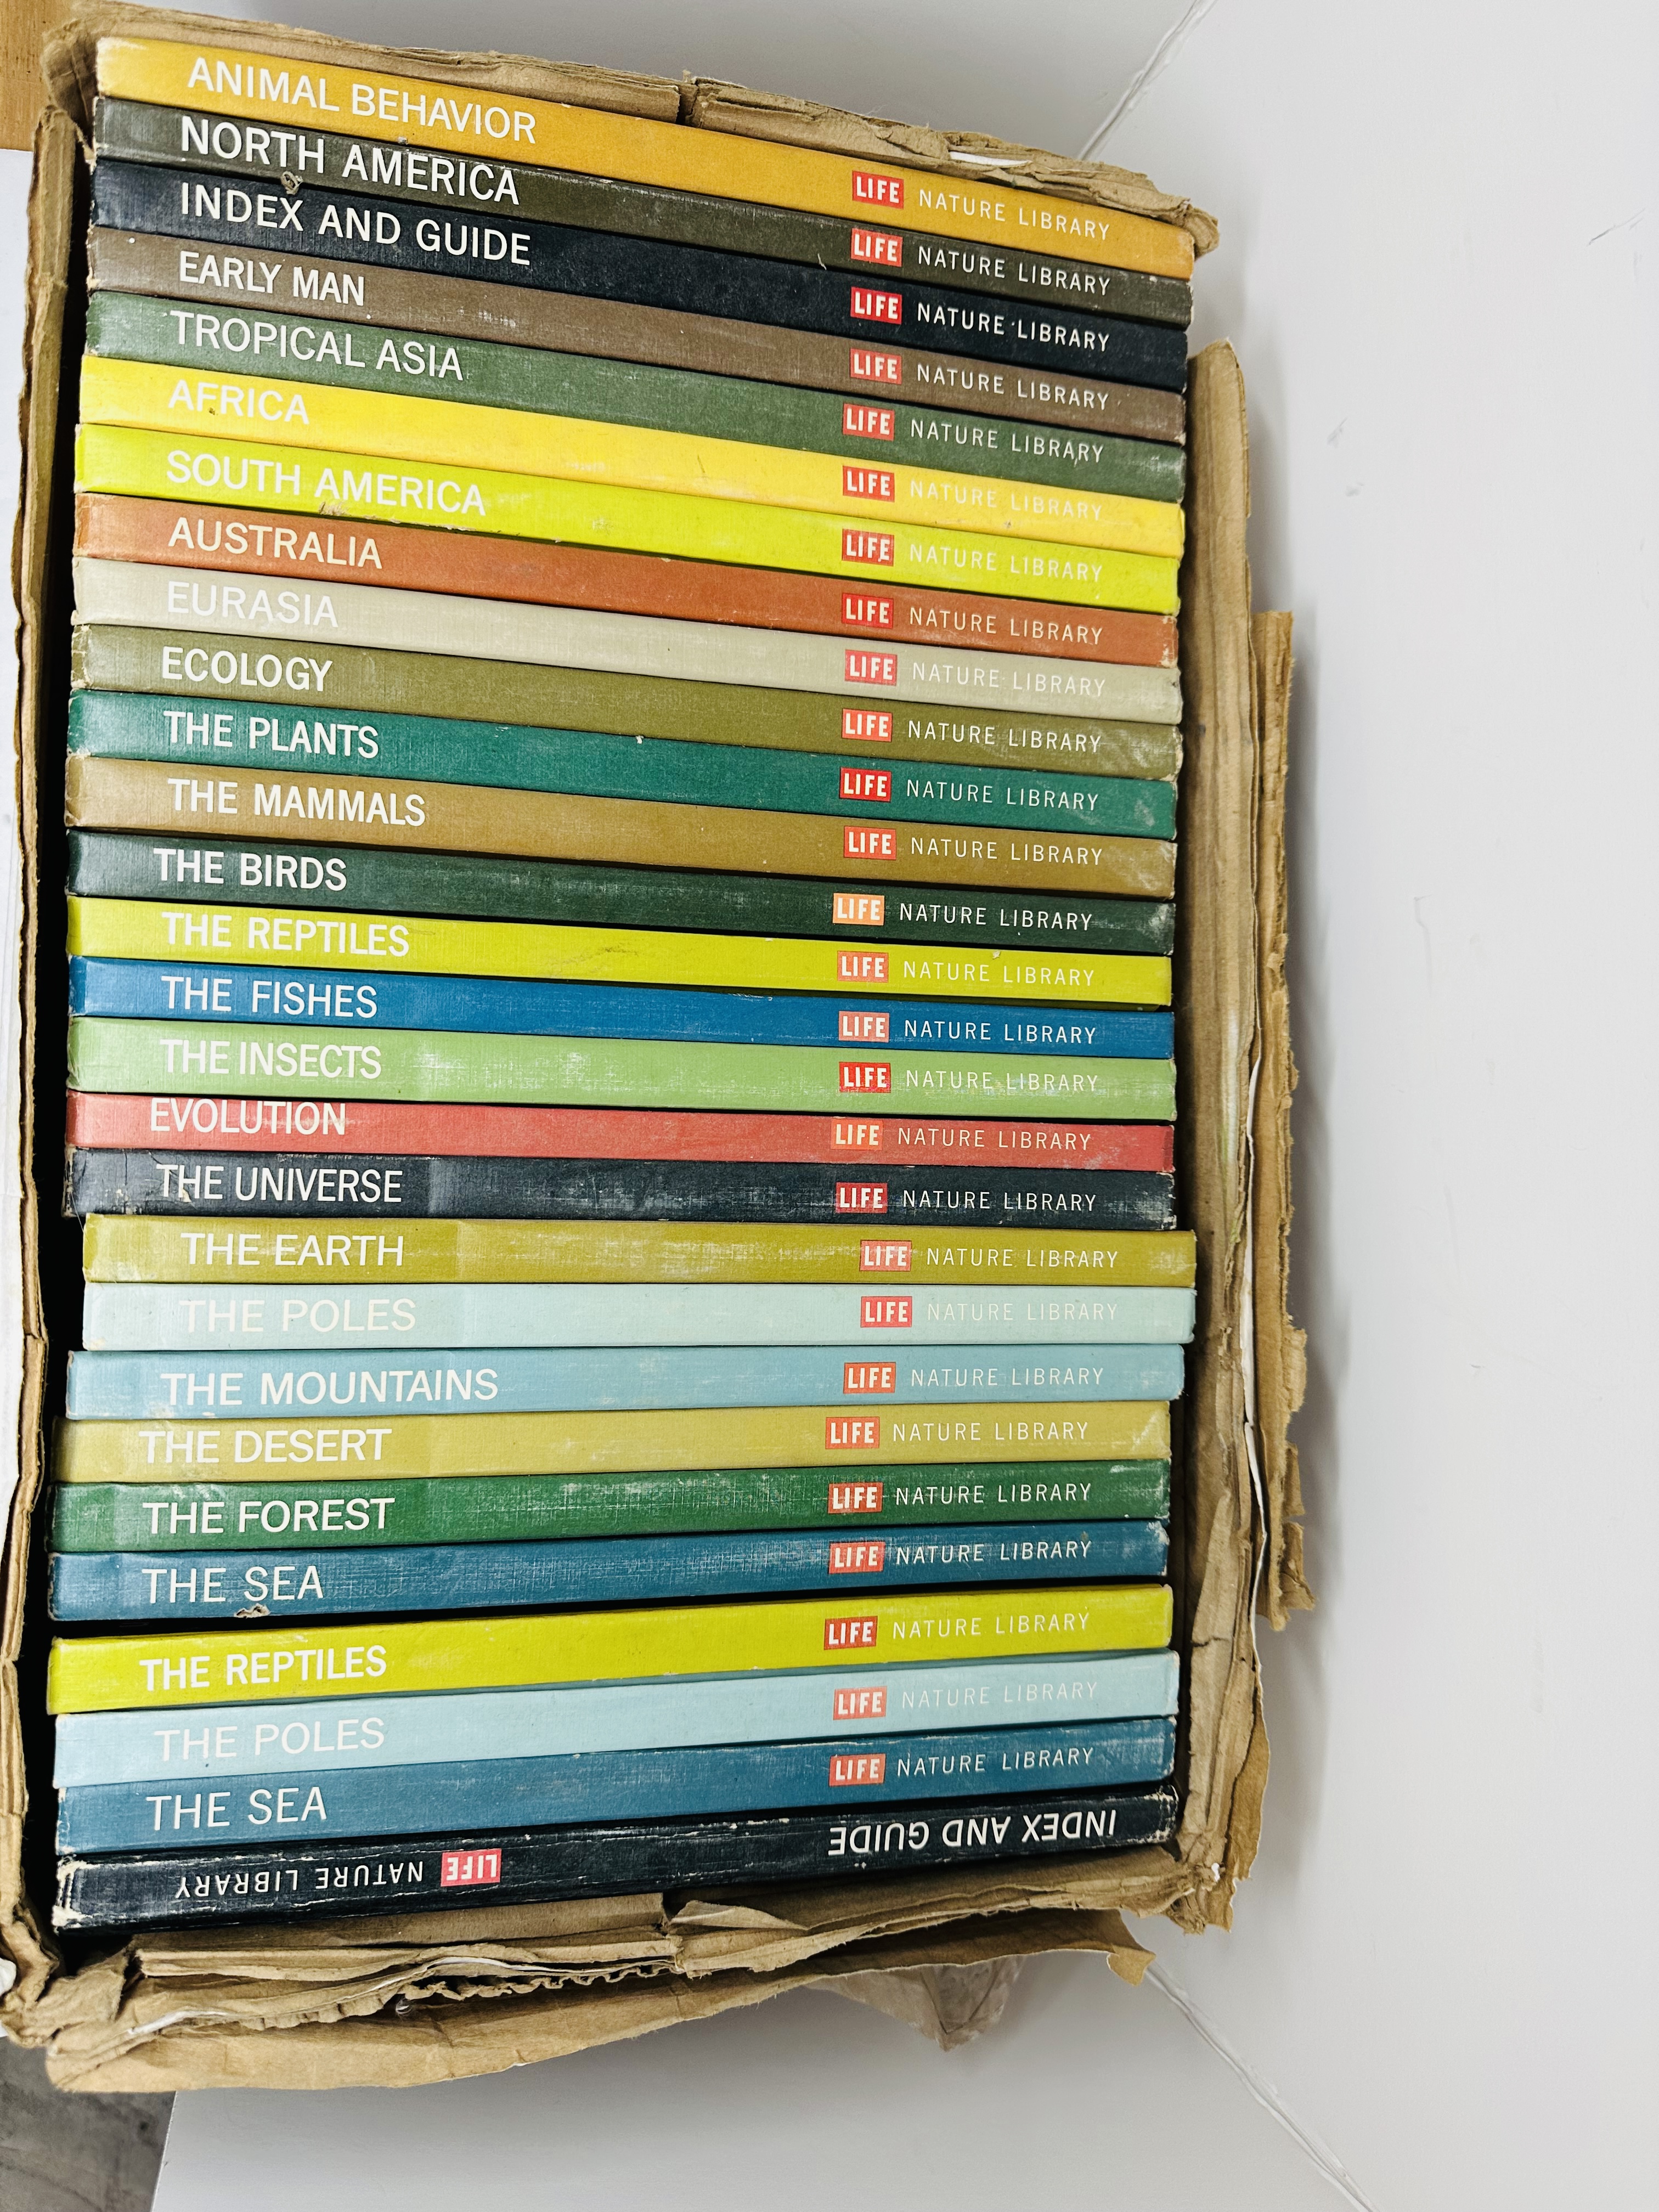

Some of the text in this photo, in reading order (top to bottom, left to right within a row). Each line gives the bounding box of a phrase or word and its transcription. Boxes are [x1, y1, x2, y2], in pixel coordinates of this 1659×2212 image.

[188, 57, 537, 145] ANIMAL BEHAVIOR
[181, 115, 520, 206] NORTH AMERICA
[181, 182, 532, 266] INDEX AND GUIDE
[856, 175, 1110, 241] LIFE NATURE LIBRARY
[178, 251, 366, 307] EARLY MAN
[854, 232, 1111, 296] LIFE NATURE LIBRARY
[854, 291, 1110, 352] LIFE NATURE LIBRARY
[169, 309, 464, 381] TROPICAL ASIA
[167, 379, 311, 425] AFRICA
[853, 352, 1109, 411] LIFE NATURE LIBRARY
[846, 408, 1104, 464] LIFE NATURE LIBRARY
[166, 449, 487, 516] SOUTH AMERICA
[847, 470, 1103, 522] LIFE NATURE LIBRARY
[167, 517, 383, 570] AUSTRALIA
[845, 534, 1103, 583] LIFE NATURE LIBRARY
[167, 581, 340, 628] EURASIA
[845, 597, 1103, 646] LIFE NATURE LIBRARY
[161, 646, 334, 692] ECOLOGY
[849, 654, 1105, 698] LIFE NATURE LIBRARY
[163, 709, 379, 760] THE PLANTS
[845, 712, 1101, 754] LIFE NATURE LIBRARY
[167, 777, 426, 827] THE MAMMALS
[843, 772, 1099, 812] LIFE NATURE LIBRARY
[153, 848, 348, 892] THE BIRDS
[848, 830, 1103, 866] LIFE NATURE LIBRARY
[161, 911, 410, 958] THE REPTILES
[837, 897, 1093, 932] LIFE NATURE LIBRARY
[841, 955, 1095, 986] LIFE NATURE LIBRARY
[161, 975, 377, 1019] THE FISHES
[842, 1015, 1096, 1045] LIFE NATURE LIBRARY
[159, 1039, 383, 1080] THE INSECTS
[843, 1066, 1098, 1092] LIFE NATURE LIBRARY
[150, 1098, 348, 1136] EVOLUTION
[835, 1123, 1092, 1151] LIFE NATURE LIBRARY
[156, 1163, 403, 1203] THE UNIVERSE
[840, 1187, 1096, 1212] LIFE NATURE LIBRARY
[180, 1232, 404, 1267] THE EARTH
[864, 1245, 1118, 1269] LIFE NATURE LIBRARY
[179, 1298, 416, 1333] THE POLES
[865, 1301, 1118, 1323] LIFE NATURE LIBRARY
[160, 1368, 499, 1406] THE MOUNTAINS
[848, 1367, 1104, 1389] LIFE NATURE LIBRARY
[138, 1428, 393, 1464] THE DESERT
[831, 1421, 1088, 1444] LIFE NATURE LIBRARY
[142, 1497, 396, 1534] THE FOREST
[832, 1482, 1092, 1510] LIFE NATURE LIBRARY
[834, 1540, 1092, 1568] LIFE NATURE LIBRARY
[142, 1565, 325, 1604] THE SEA
[828, 1612, 1090, 1646] LIFE NATURE LIBRARY
[139, 1644, 388, 1692] THE REPTILES
[838, 1681, 1098, 1715] LIFE NATURE LIBRARY
[154, 1717, 386, 1762] THE POLES
[835, 1746, 1094, 1781] LIFE NATURE LIBRARY
[146, 1786, 328, 1832] THE SEA
[828, 1809, 1117, 1856] INDEX AND GUIDE
[174, 1853, 499, 1900] LIFE NATURE LIBRARY
